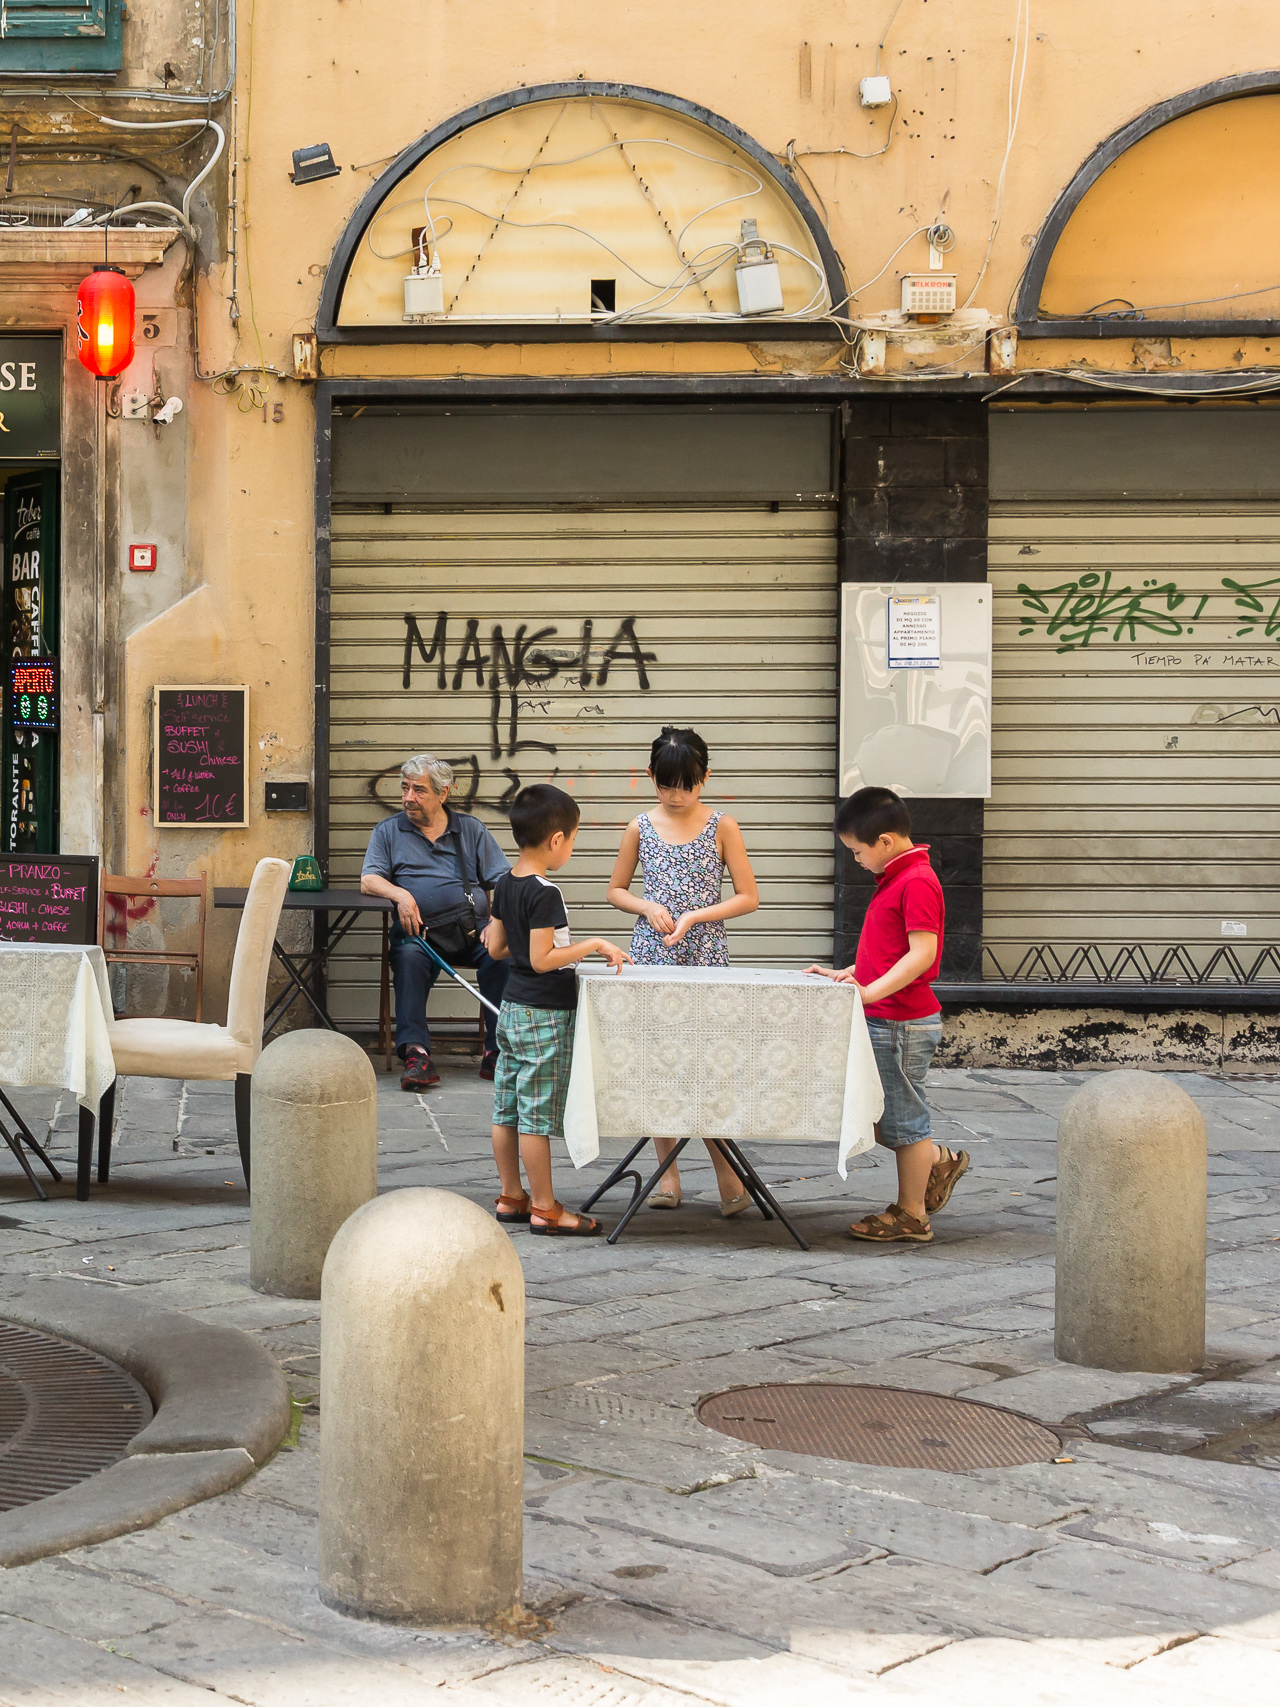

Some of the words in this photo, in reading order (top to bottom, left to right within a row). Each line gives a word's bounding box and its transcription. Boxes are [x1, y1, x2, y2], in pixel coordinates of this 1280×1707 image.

[142, 314, 161, 340] 3
[262, 402, 285, 424] 15
[11, 550, 40, 582] BAR
[402, 610, 658, 690] MANGIA
[1131, 652, 1182, 666] TIEMPO
[1223, 655, 1280, 667] MATAR
[13, 668, 54, 693] APERTO
[184, 694, 219, 708] LUNCH
[164, 725, 210, 737] BUFFET
[166, 740, 210, 754] SUSHI
[199, 752, 241, 766] Chinese
[8, 864, 60, 879] PRANZO
[50, 883, 88, 903] BUFFET
